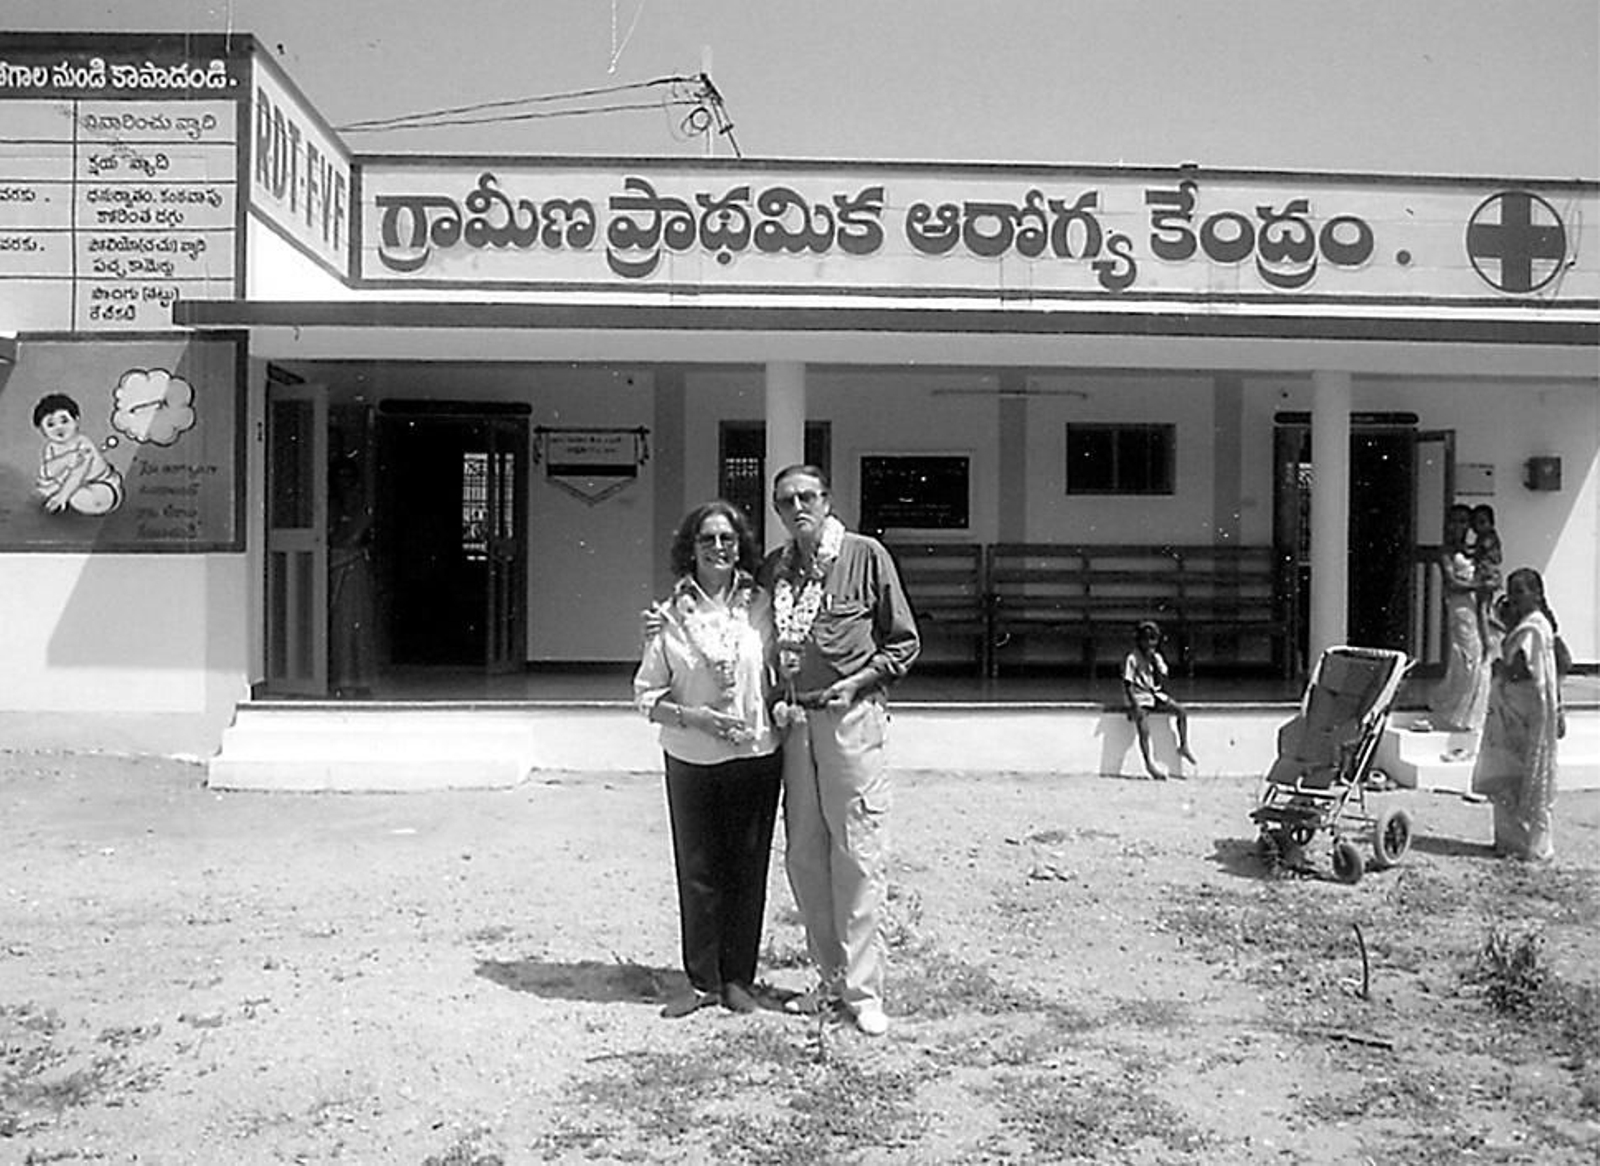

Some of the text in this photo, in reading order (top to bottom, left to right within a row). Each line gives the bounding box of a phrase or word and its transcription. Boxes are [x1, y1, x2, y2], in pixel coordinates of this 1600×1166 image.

[53, 57, 106, 88] నుండి
[374, 171, 597, 273] గ్రామీణ
[906, 189, 1138, 291] ఆరోగ్య
